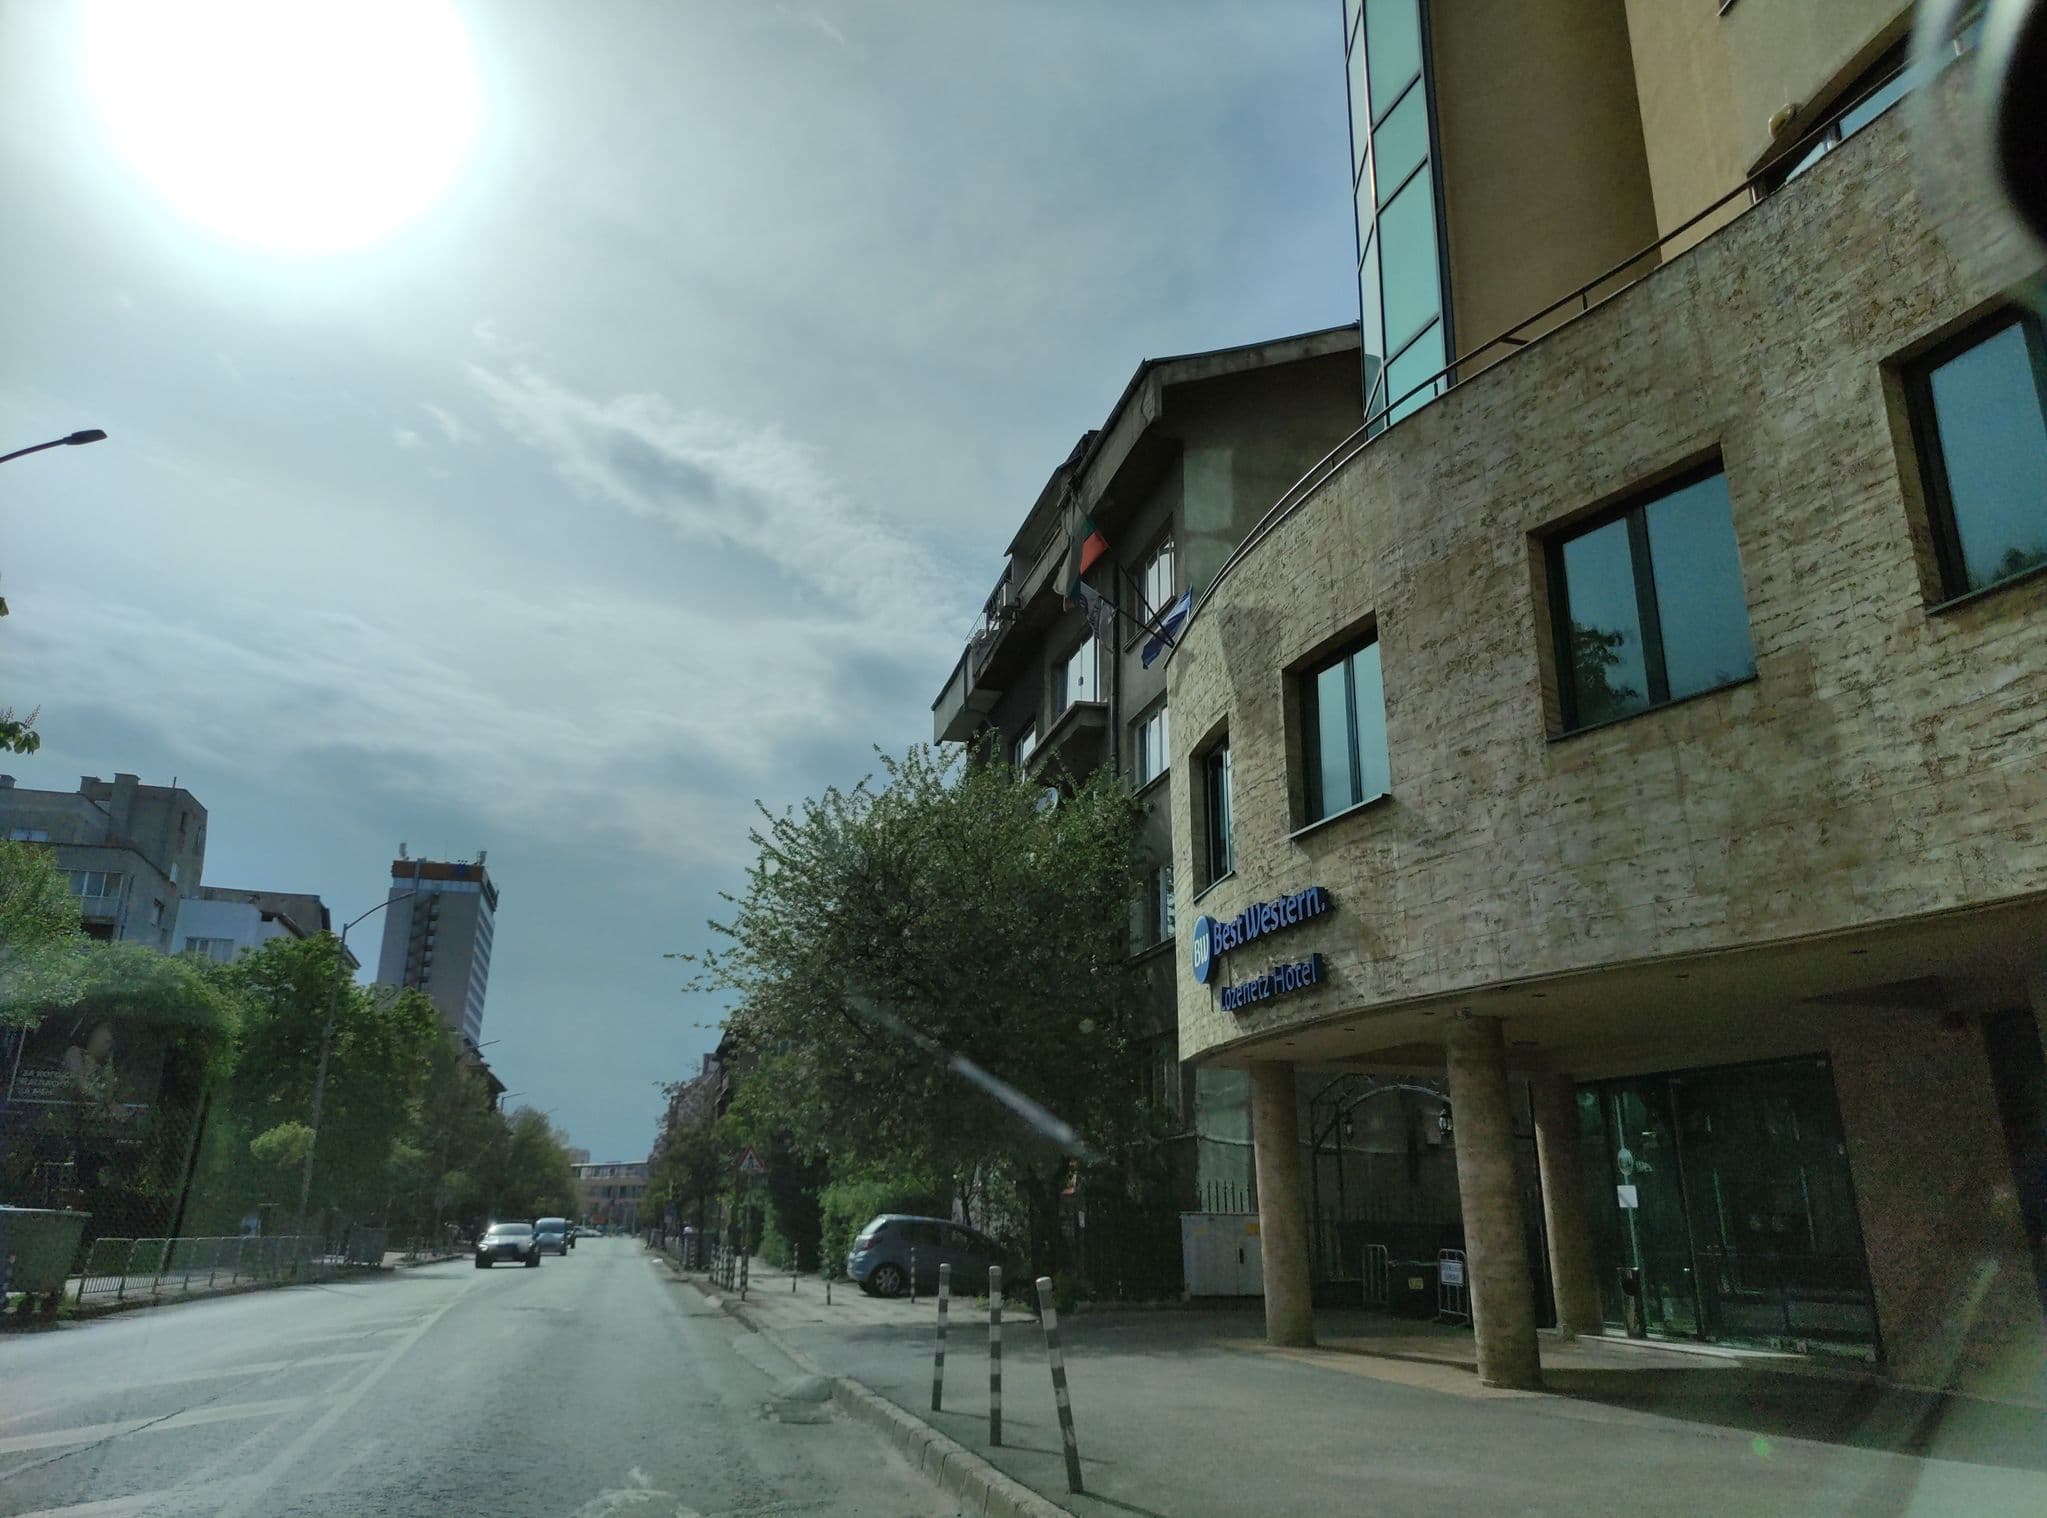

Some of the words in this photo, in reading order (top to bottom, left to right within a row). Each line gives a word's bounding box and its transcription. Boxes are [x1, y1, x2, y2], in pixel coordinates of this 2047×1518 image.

[1194, 932, 1209, 968] BW
[1213, 914, 1244, 955] Best
[1273, 953, 1317, 994] Hotel
